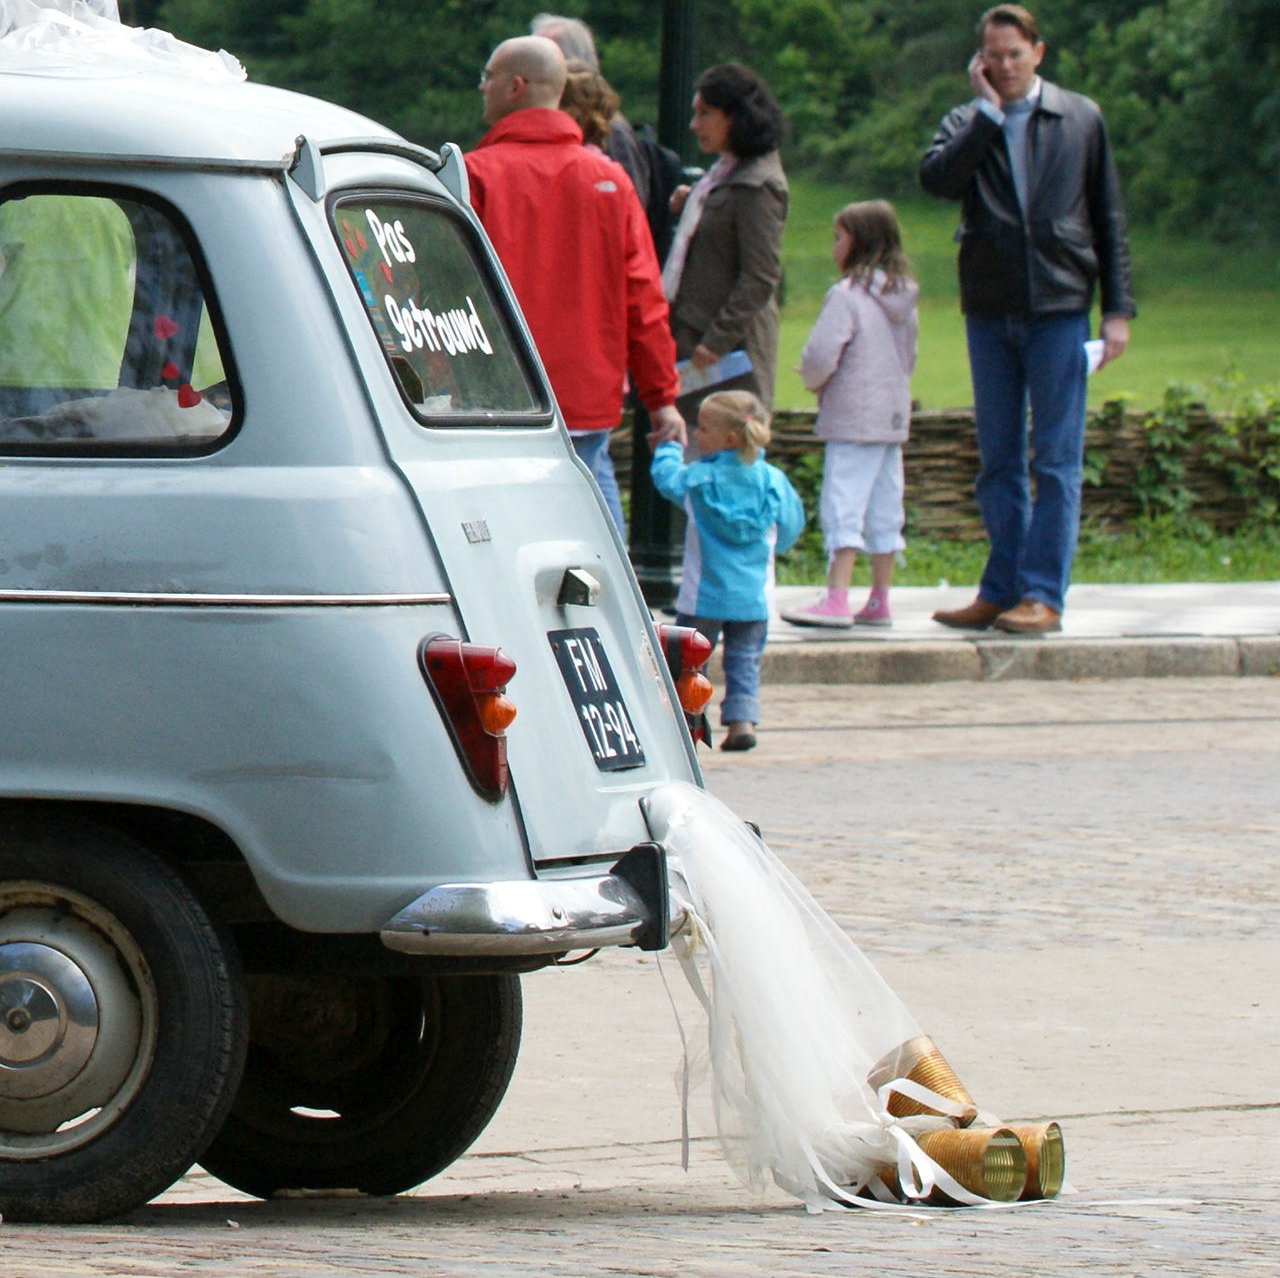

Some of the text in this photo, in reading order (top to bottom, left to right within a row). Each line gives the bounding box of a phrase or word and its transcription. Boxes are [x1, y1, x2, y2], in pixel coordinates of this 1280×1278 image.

[365, 208, 416, 267] Pas
[564, 637, 608, 692] FM
[581, 700, 640, 758] 12-94
